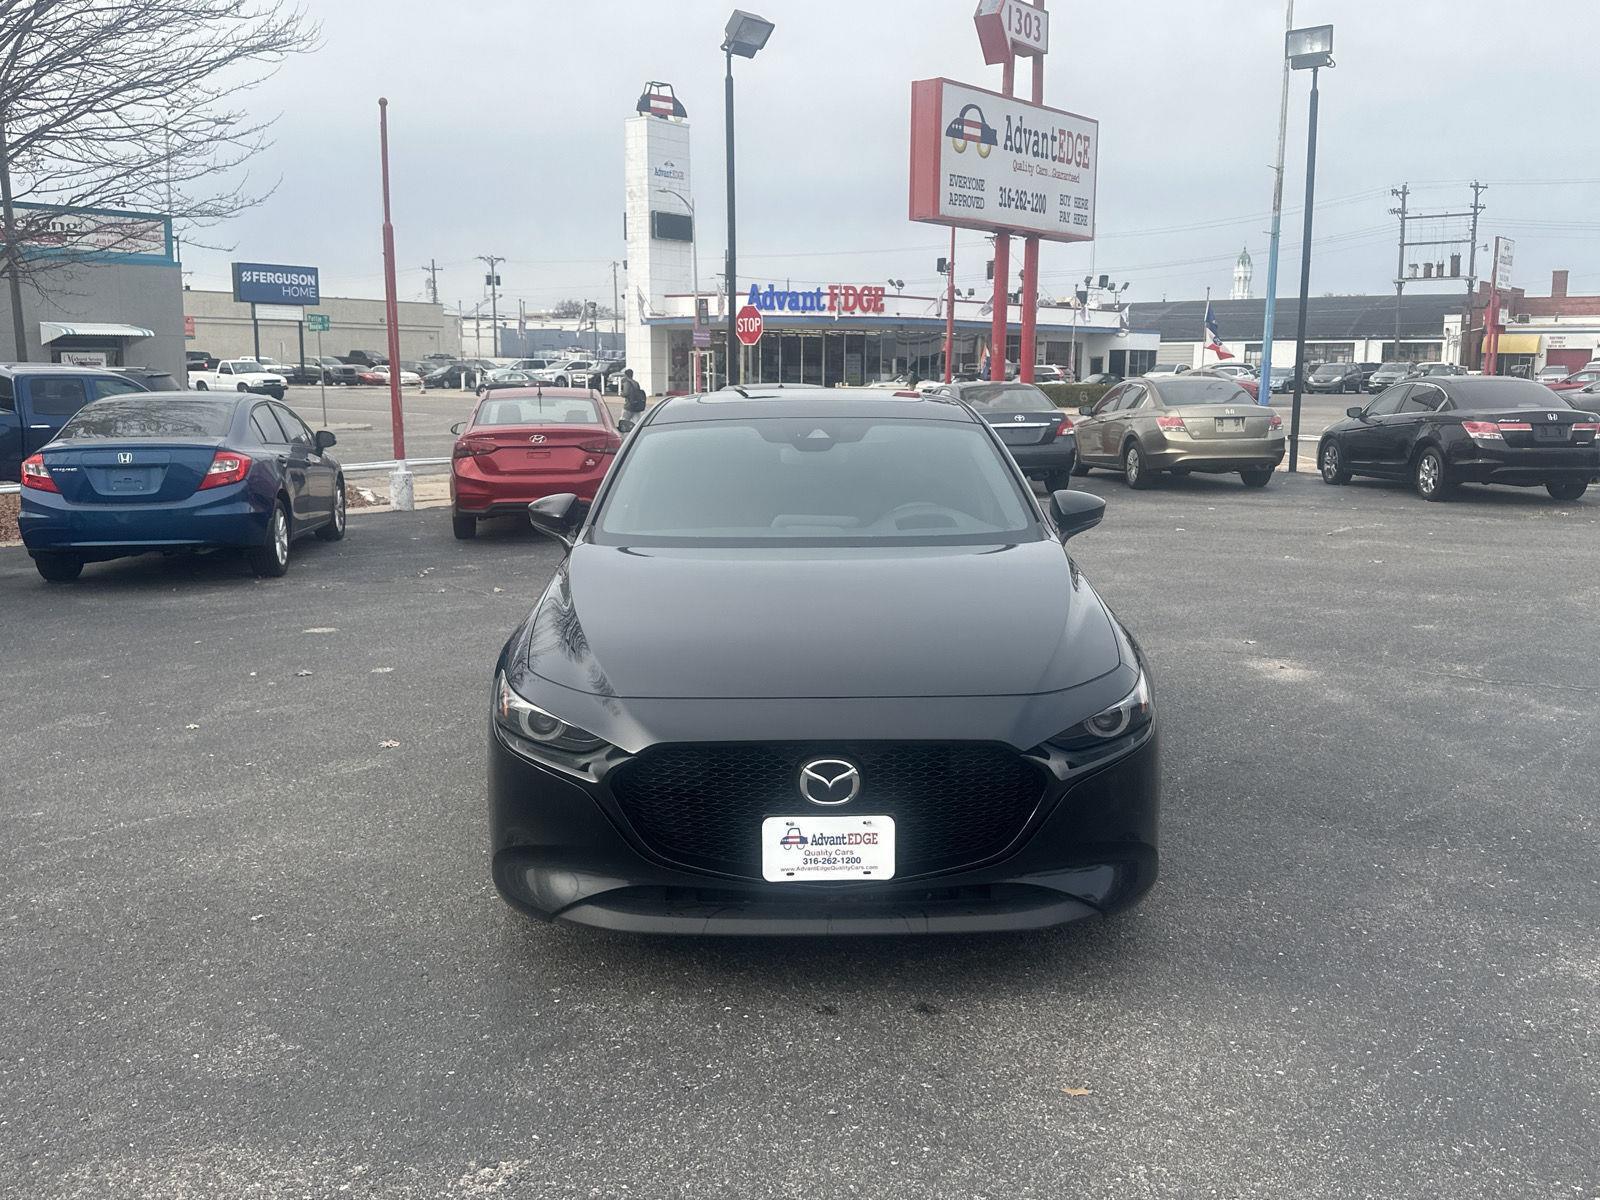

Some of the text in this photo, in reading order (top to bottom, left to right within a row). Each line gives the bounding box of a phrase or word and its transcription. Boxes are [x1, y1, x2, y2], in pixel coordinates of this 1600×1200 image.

[1008, 4, 1041, 42] 1303
[1003, 114, 1091, 170] AdvantEDGE
[1012, 159, 1035, 177] Quality
[948, 173, 986, 192] EVERYONE
[948, 192, 985, 210] APPROVED
[998, 186, 1047, 214] 316-262-1200
[1059, 193, 1089, 211] BUY HERE
[1059, 210, 1088, 226] PAY HERE
[252, 271, 316, 286] FERGUSON
[282, 286, 316, 298] HOME
[737, 317, 761, 333] STOP
[810, 832, 879, 847] AdvantEDGE
[802, 856, 862, 865] 316-262-1200
